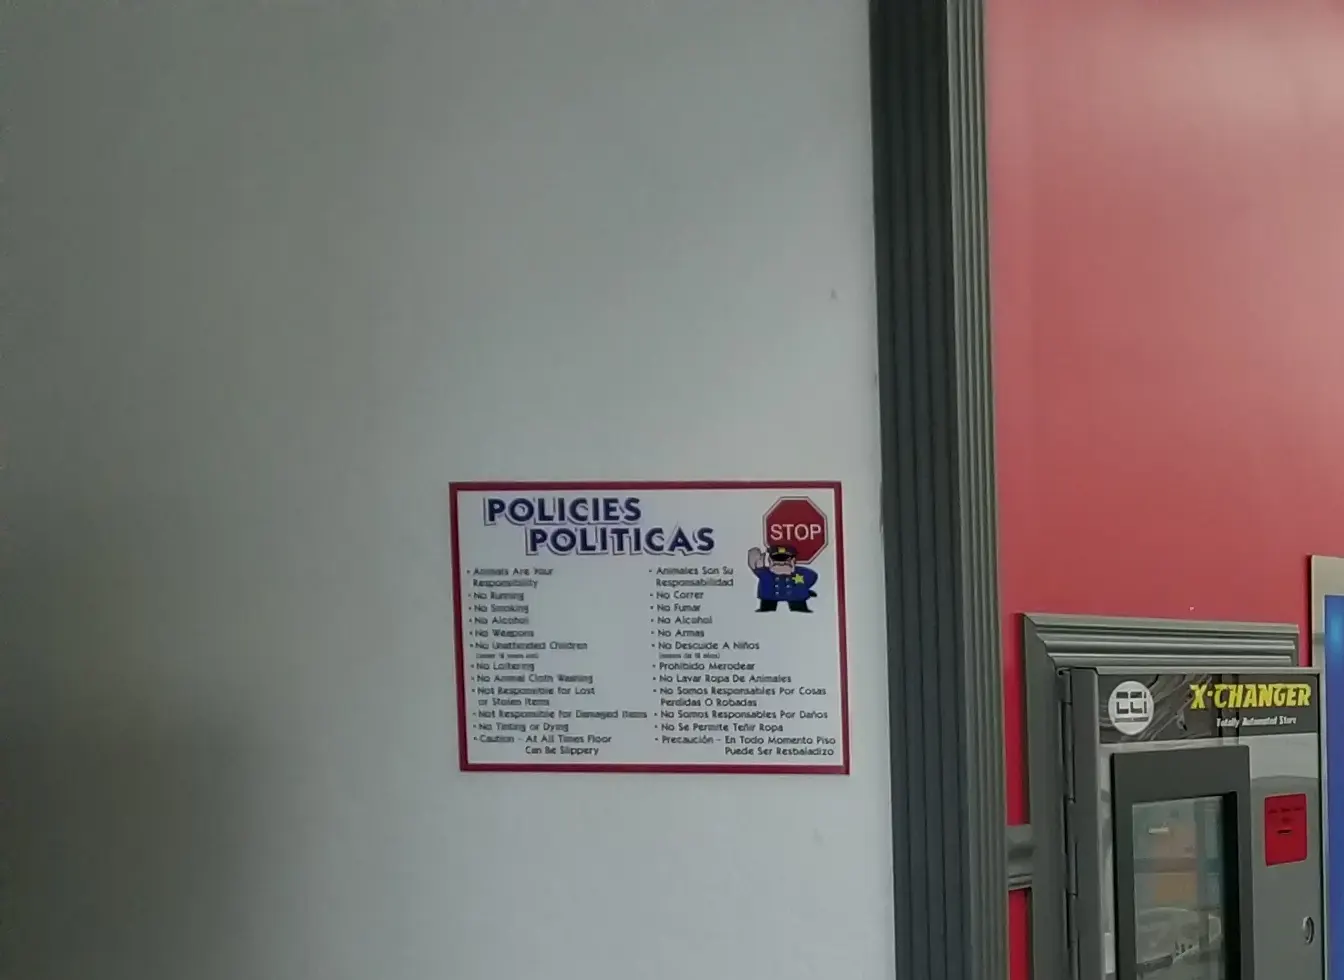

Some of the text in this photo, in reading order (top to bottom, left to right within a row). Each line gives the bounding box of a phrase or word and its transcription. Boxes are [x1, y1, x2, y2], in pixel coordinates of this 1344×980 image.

[485, 496, 642, 523] POLICIES
[770, 523, 822, 541] STOP
[527, 526, 715, 553] POLITICAS
[656, 567, 733, 575] Animales Son Su
[656, 579, 734, 587] Responsabilidad
[474, 592, 487, 600] No
[656, 591, 704, 599] No Correr
[474, 604, 488, 612] No
[657, 604, 701, 612] No Fumar
[475, 616, 529, 625] No Alcohol
[657, 616, 713, 625] No Alcohol
[475, 629, 489, 637] No
[658, 629, 705, 637] No Armas
[476, 642, 489, 650] No
[658, 642, 672, 650] No
[733, 641, 760, 650] Niños
[476, 662, 490, 670] No
[659, 662, 755, 670] Prohibido Merodear
[476, 674, 490, 682] No
[659, 674, 673, 682] No
[676, 675, 701, 683] Lavar
[705, 675, 730, 684] Ropa
[749, 674, 792, 683] Animales
[477, 687, 495, 695] Not
[575, 687, 595, 695] Lost
[660, 687, 826, 696] No Somos Responsables Por Cosas
[661, 698, 757, 707] Perdidas O Robadas
[661, 710, 828, 720] No Somos Responsables Por Daños
[478, 723, 492, 731] No
[543, 723, 569, 732] Dying
[661, 723, 675, 731] No
[678, 723, 689, 731] Se
[692, 723, 729, 731] Permite
[759, 723, 784, 733] Ropa
[525, 735, 537, 743] At
[541, 735, 554, 743] All
[558, 735, 584, 743] Times
[587, 735, 612, 743] Floor
[661, 735, 714, 744] Precaución
[725, 736, 736, 744] En
[740, 736, 764, 744] Todo
[767, 736, 813, 744] Momento
[816, 736, 836, 744] Piso
[525, 746, 600, 757] Can Be Slippery
[725, 747, 834, 756] Puede Ser Resbaladizo
